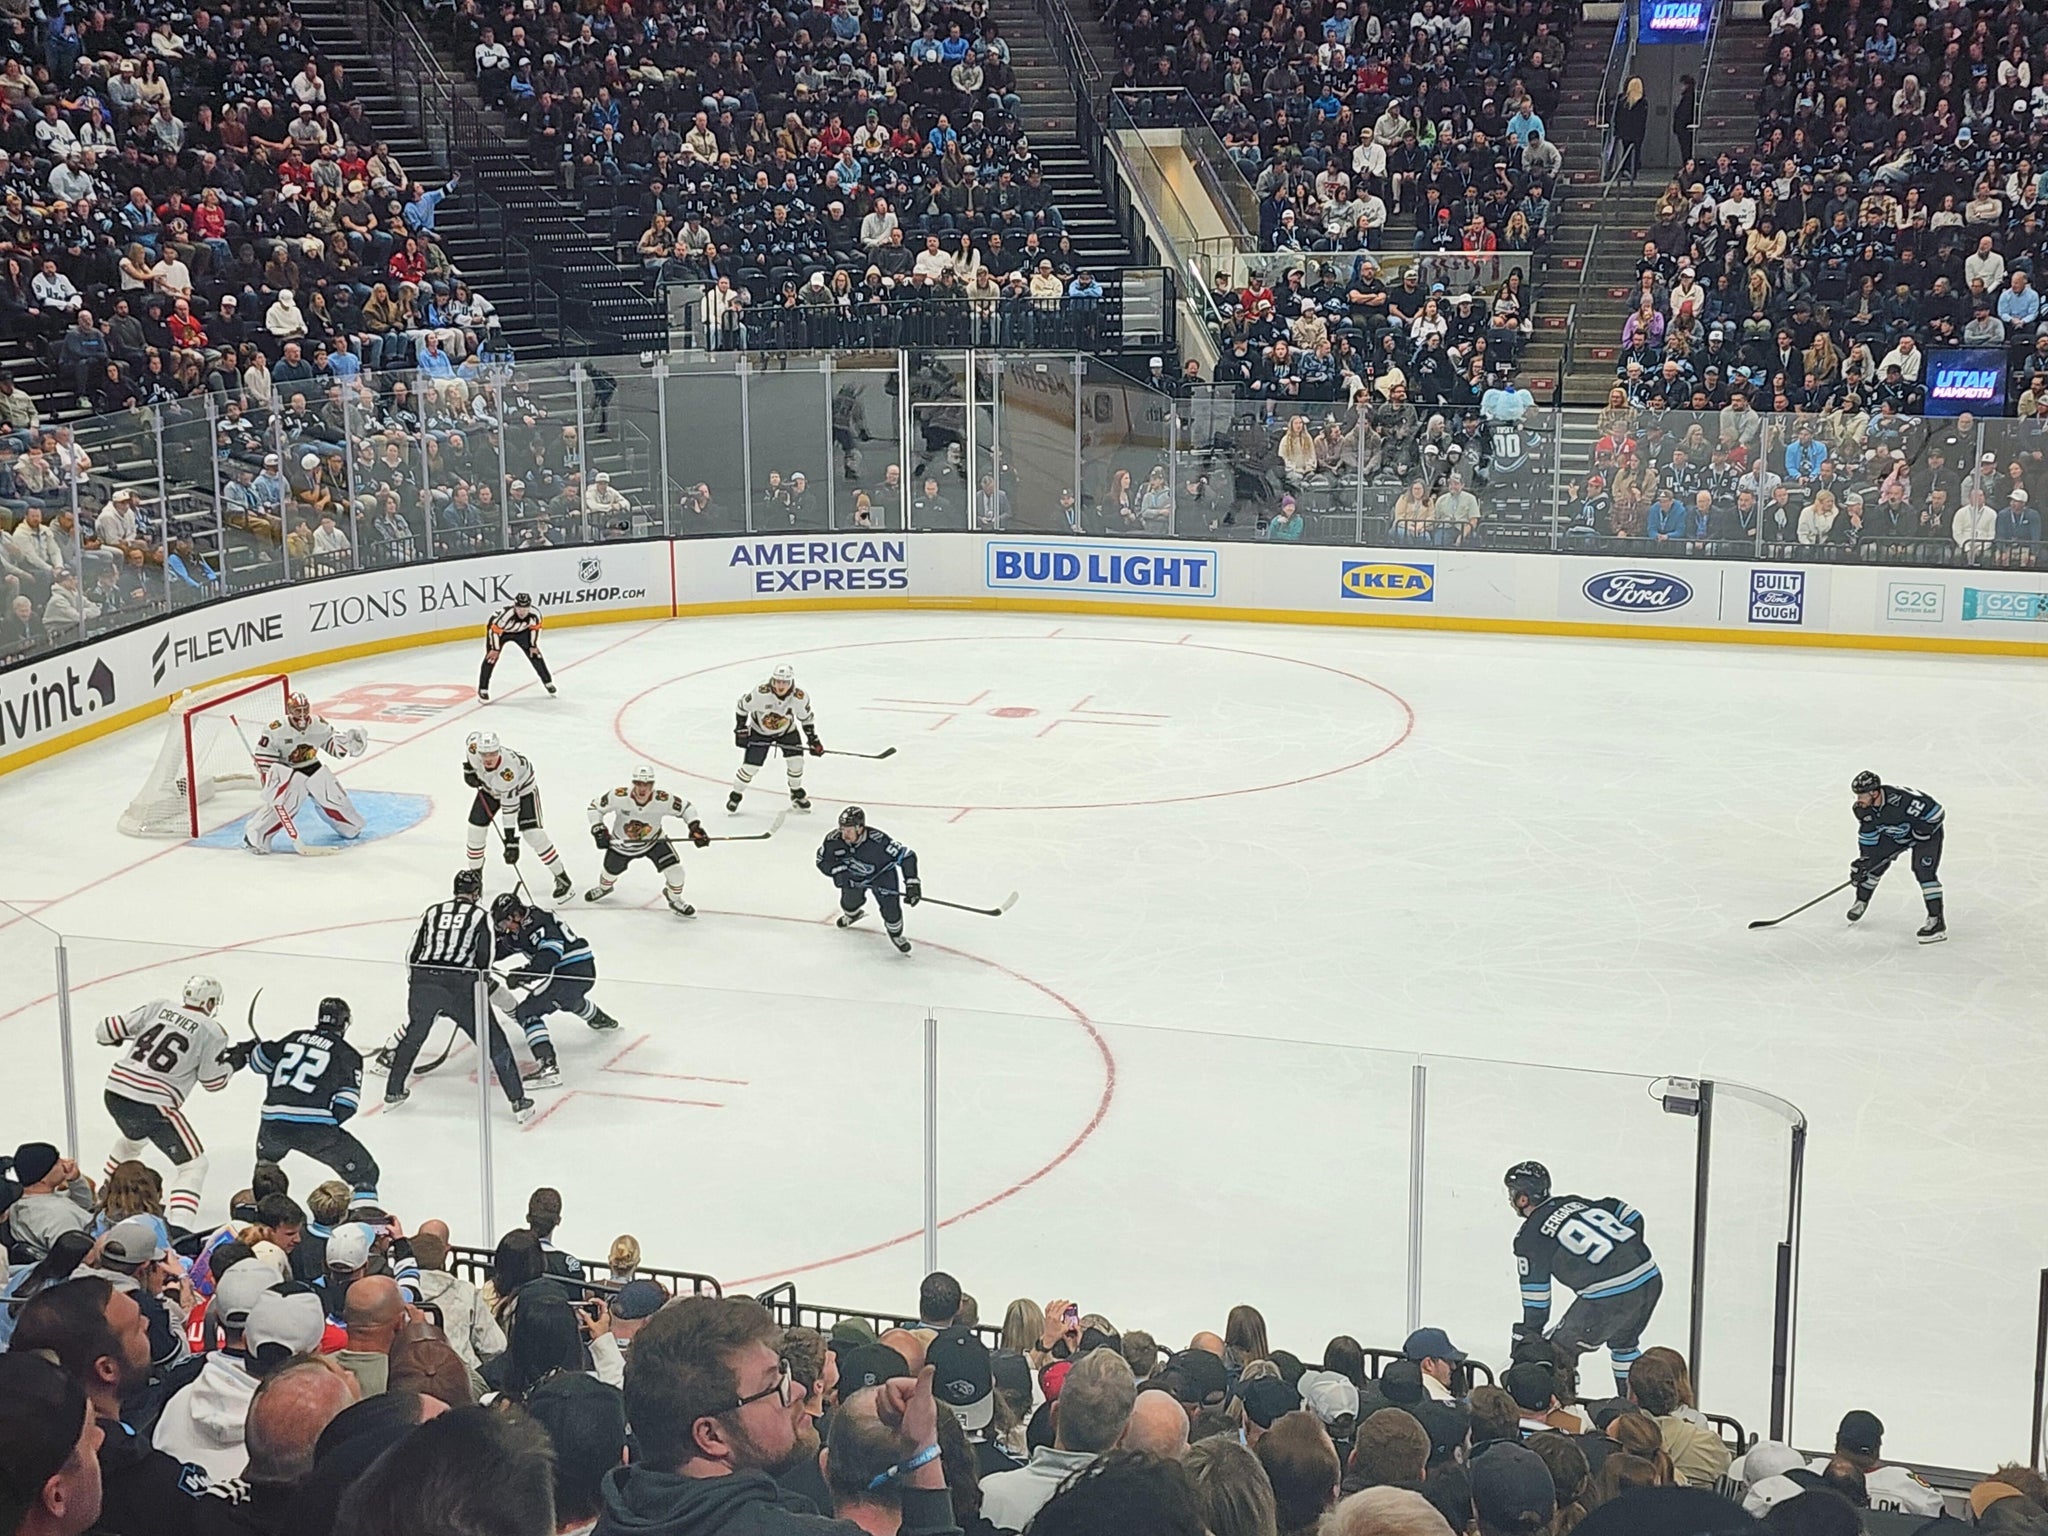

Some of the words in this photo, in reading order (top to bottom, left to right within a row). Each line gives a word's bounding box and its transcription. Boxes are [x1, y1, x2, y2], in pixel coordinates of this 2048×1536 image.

[1654, 3, 1702, 19] UTAH
[1650, 17, 1699, 29] MAMMOTH
[1936, 370, 1998, 388] UTAH
[1932, 387, 1994, 398] MAMMOTH
[1493, 434, 1520, 458] 00
[729, 541, 904, 566] AMERICAN
[996, 551, 1081, 582] BUD
[1089, 555, 1208, 588] LIGHT
[756, 568, 908, 592] EXPRESS
[1351, 572, 1426, 590] IKEA
[1756, 575, 1800, 590] BUILT
[1603, 576, 1673, 606] Ford
[1764, 592, 1789, 603] Ford
[1894, 590, 1937, 607] G2G
[309, 588, 407, 633] ZIONS
[418, 573, 516, 613] BANK
[1986, 594, 2029, 611] G2G
[1754, 606, 1798, 620] TOUGH
[174, 613, 284, 668] FILEVINE
[1906, 799, 1926, 817] 52
[438, 913, 465, 930] 89
[529, 927, 546, 945] 27
[158, 1008, 199, 1034] CREVIER
[129, 1022, 190, 1073] 46
[272, 1043, 331, 1093] 22
[1557, 1208, 1637, 1264] 98
